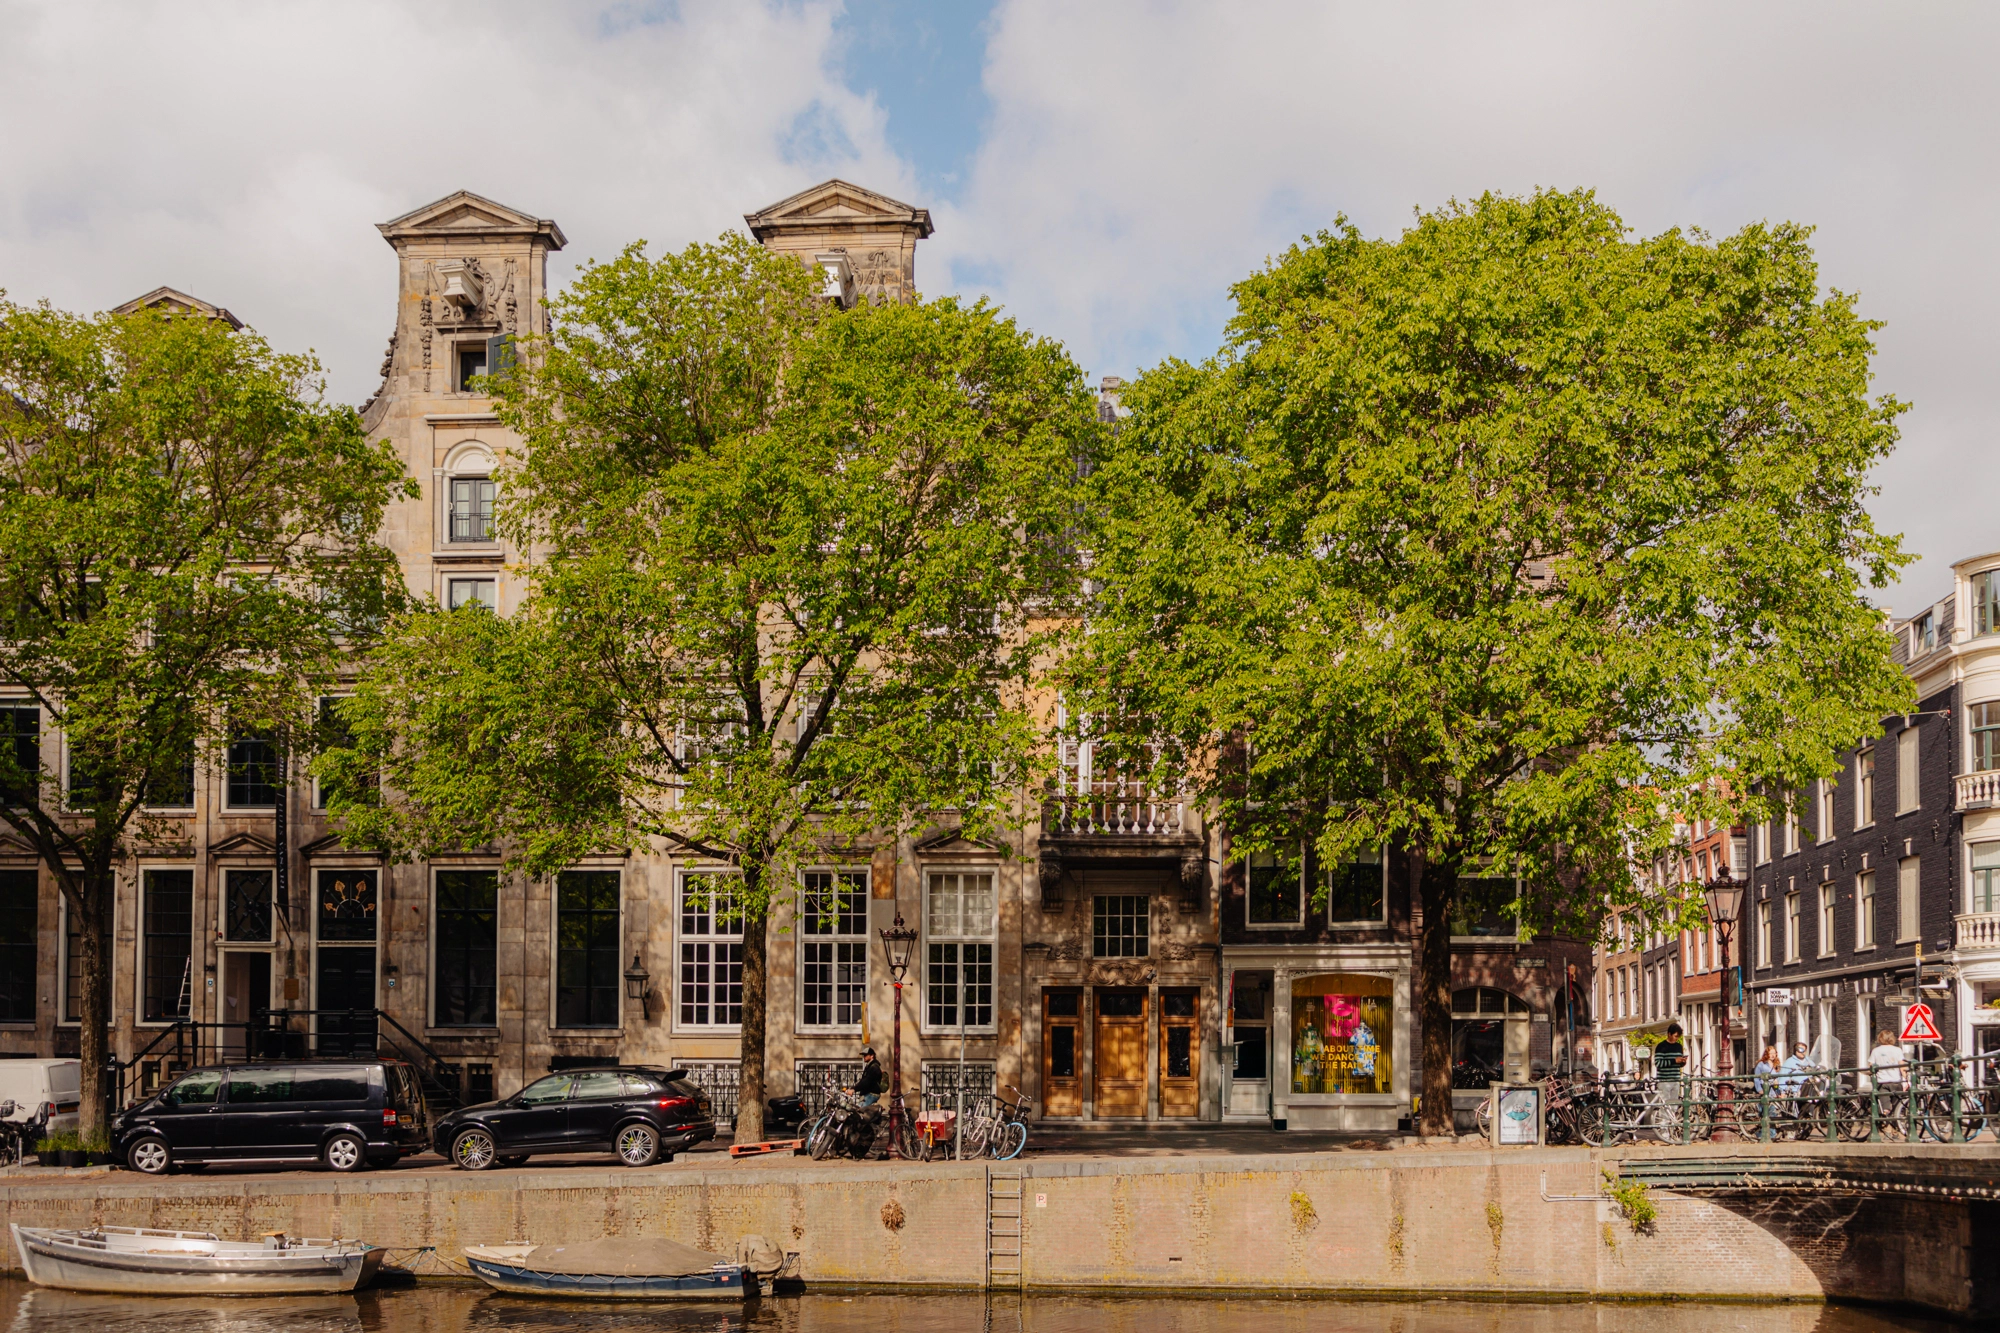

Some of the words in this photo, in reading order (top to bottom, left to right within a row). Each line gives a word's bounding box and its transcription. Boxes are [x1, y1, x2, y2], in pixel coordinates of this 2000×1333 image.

[1324, 1045, 1355, 1053] ABOUT
[1357, 1045, 1381, 1053] TIME
[1310, 1053, 1326, 1061] WE
[1329, 1053, 1359, 1061] DANCE
[1363, 1053, 1373, 1061] IN
